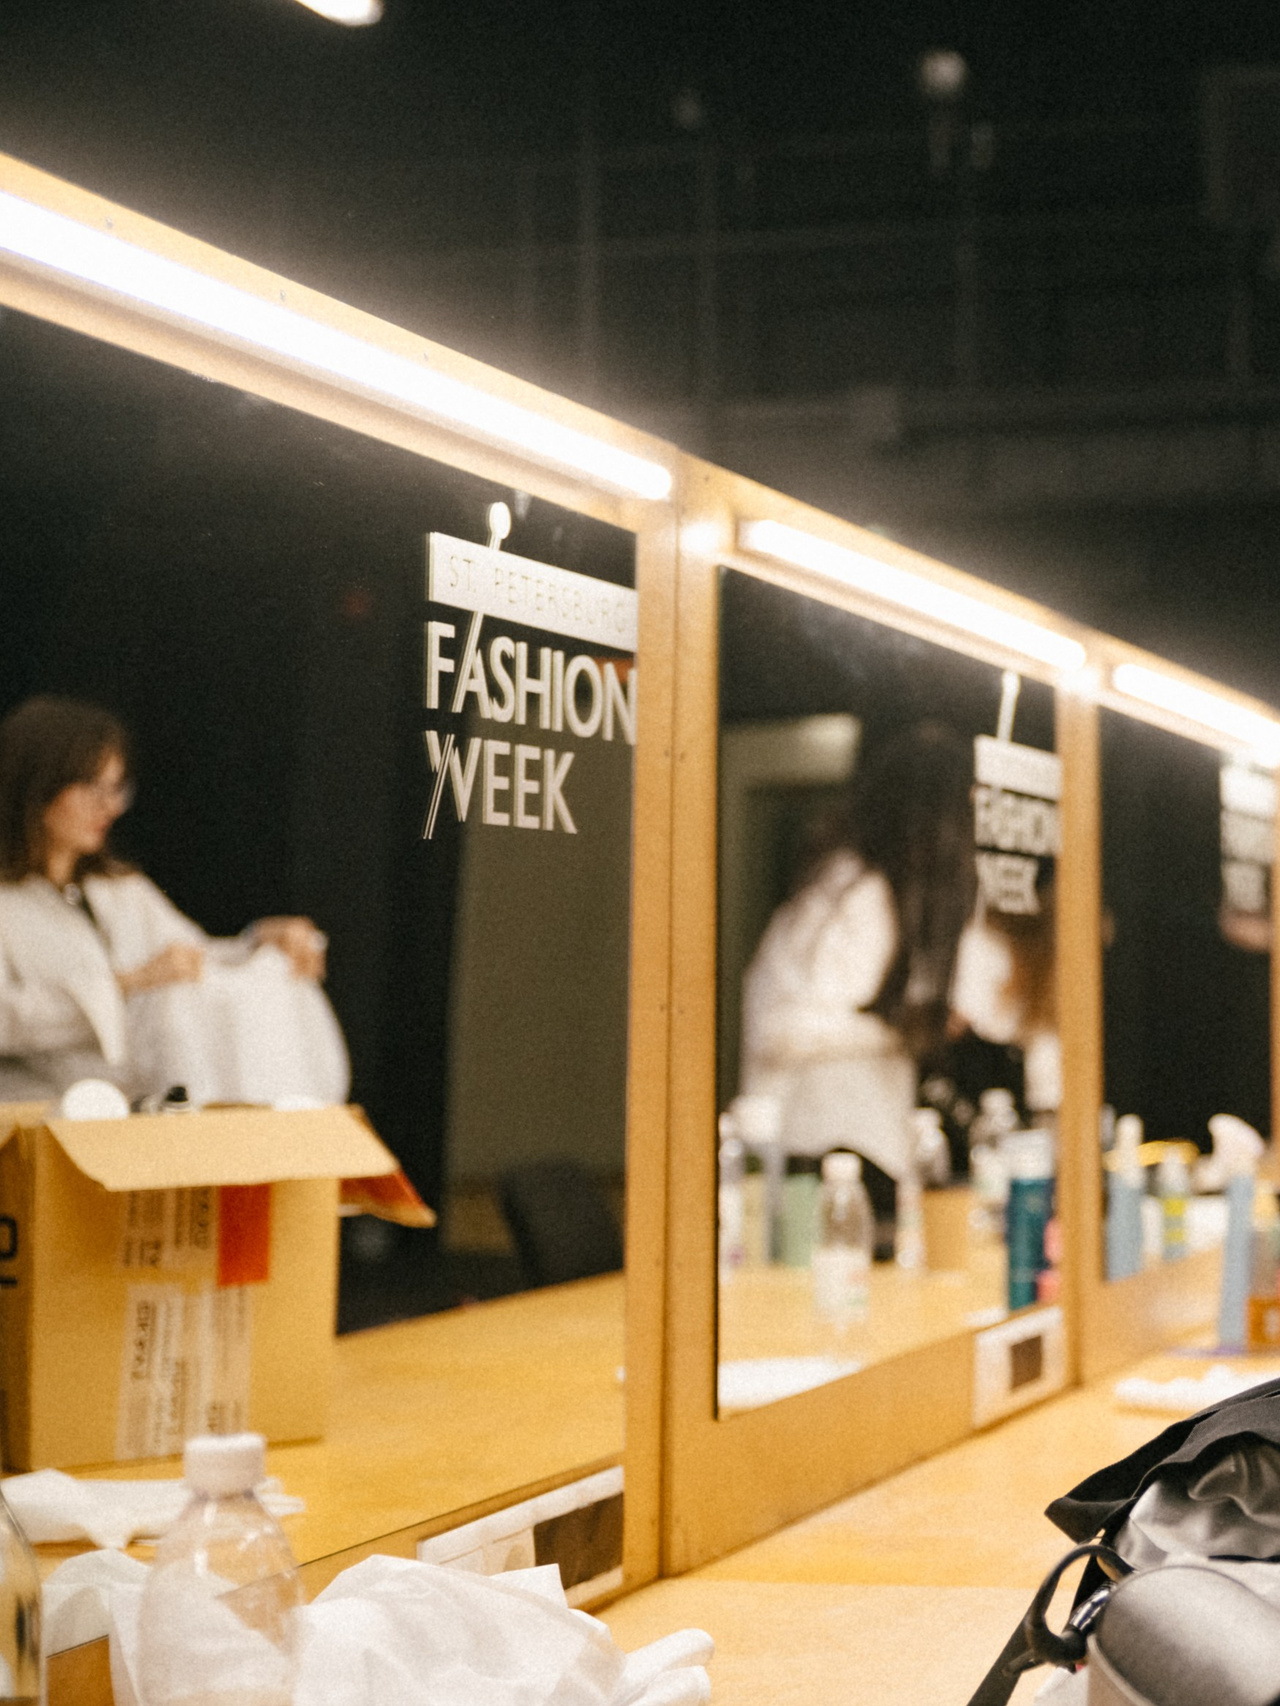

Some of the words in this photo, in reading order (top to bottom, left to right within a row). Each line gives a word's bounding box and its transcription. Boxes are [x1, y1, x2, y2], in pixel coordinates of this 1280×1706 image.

[494, 566, 627, 635] PETERSBURG
[425, 620, 637, 746] FASHION
[424, 730, 577, 838] WEEK
